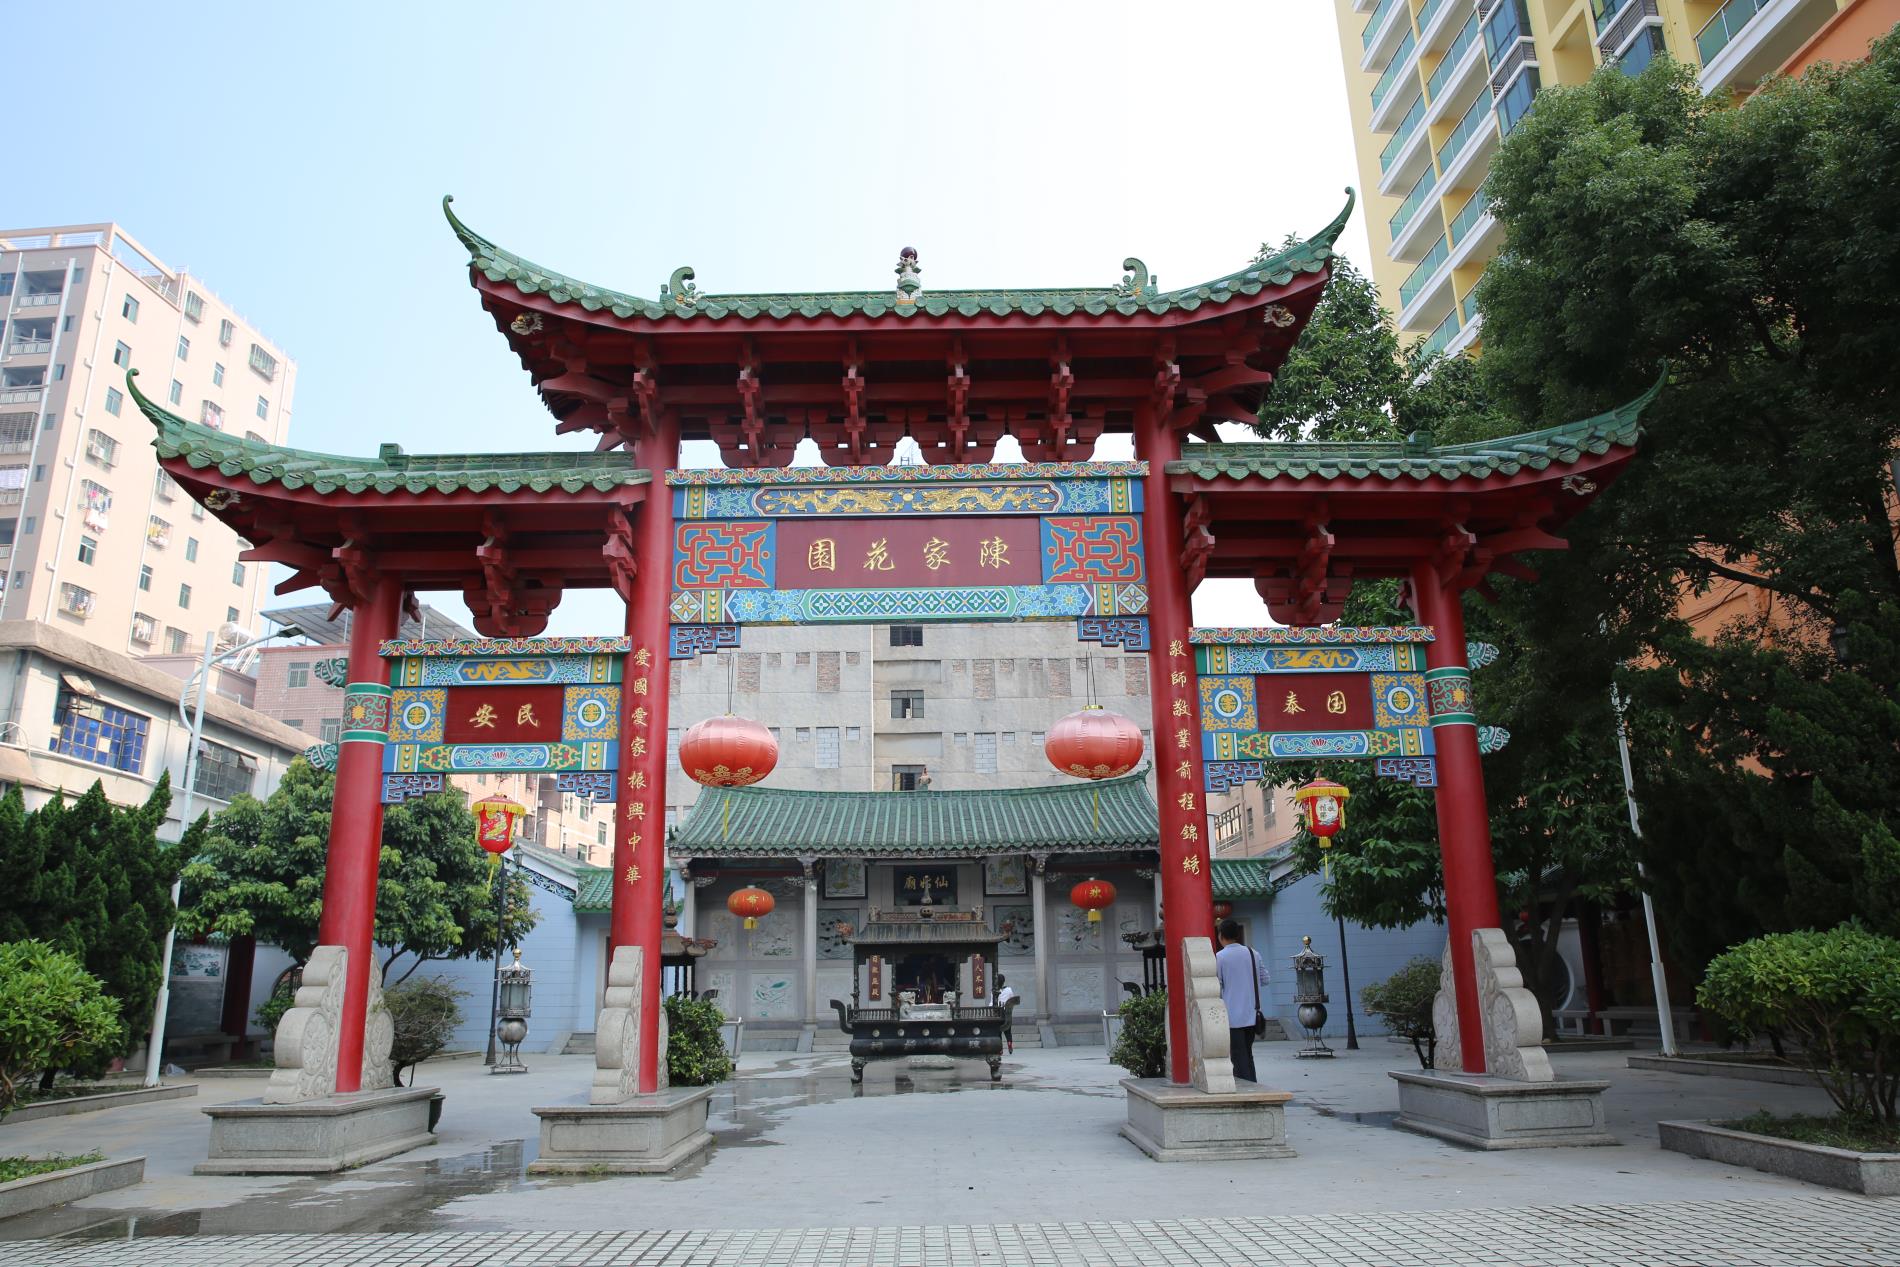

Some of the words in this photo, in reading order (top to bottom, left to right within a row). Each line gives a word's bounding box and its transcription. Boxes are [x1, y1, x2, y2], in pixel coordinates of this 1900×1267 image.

[624, 648, 651, 885] 愛國愛家振興中華
